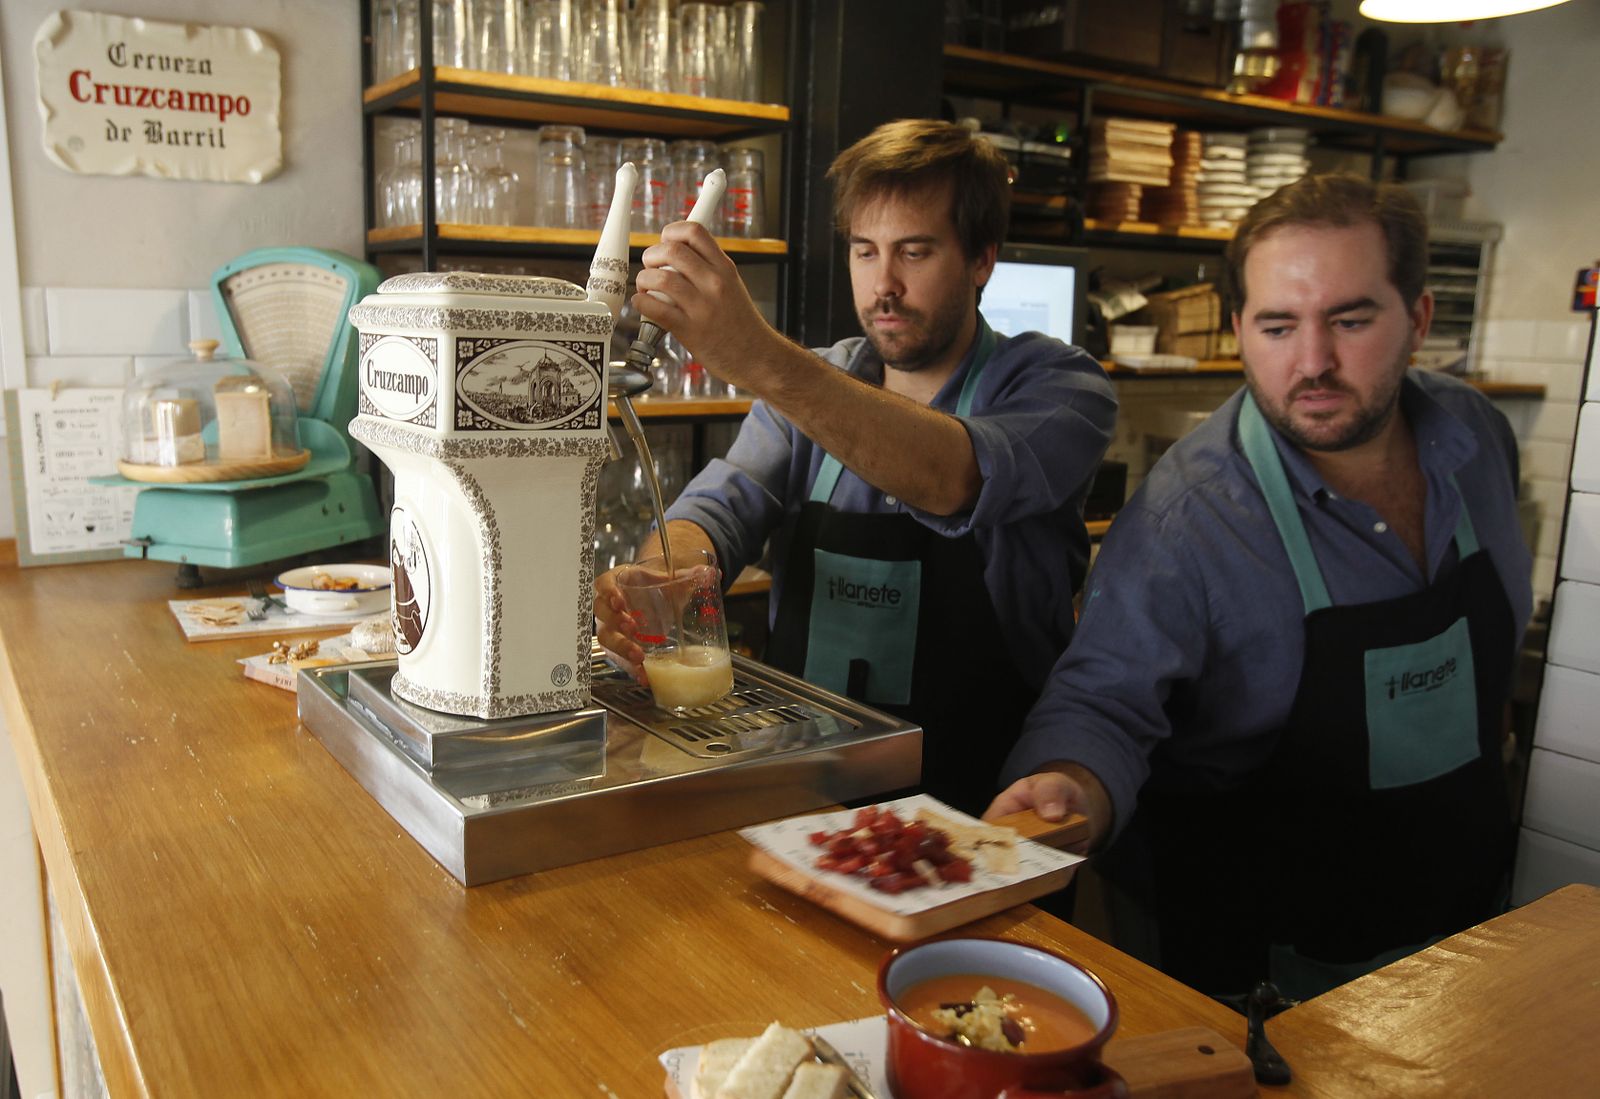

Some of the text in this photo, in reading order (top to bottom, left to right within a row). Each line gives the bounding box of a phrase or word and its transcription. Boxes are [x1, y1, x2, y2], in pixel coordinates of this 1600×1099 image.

[107, 42, 213, 76] Cerveza
[68, 69, 252, 123] Cruzcampo
[104, 118, 227, 149] de Barril
[367, 358, 429, 405] Cruzcampo
